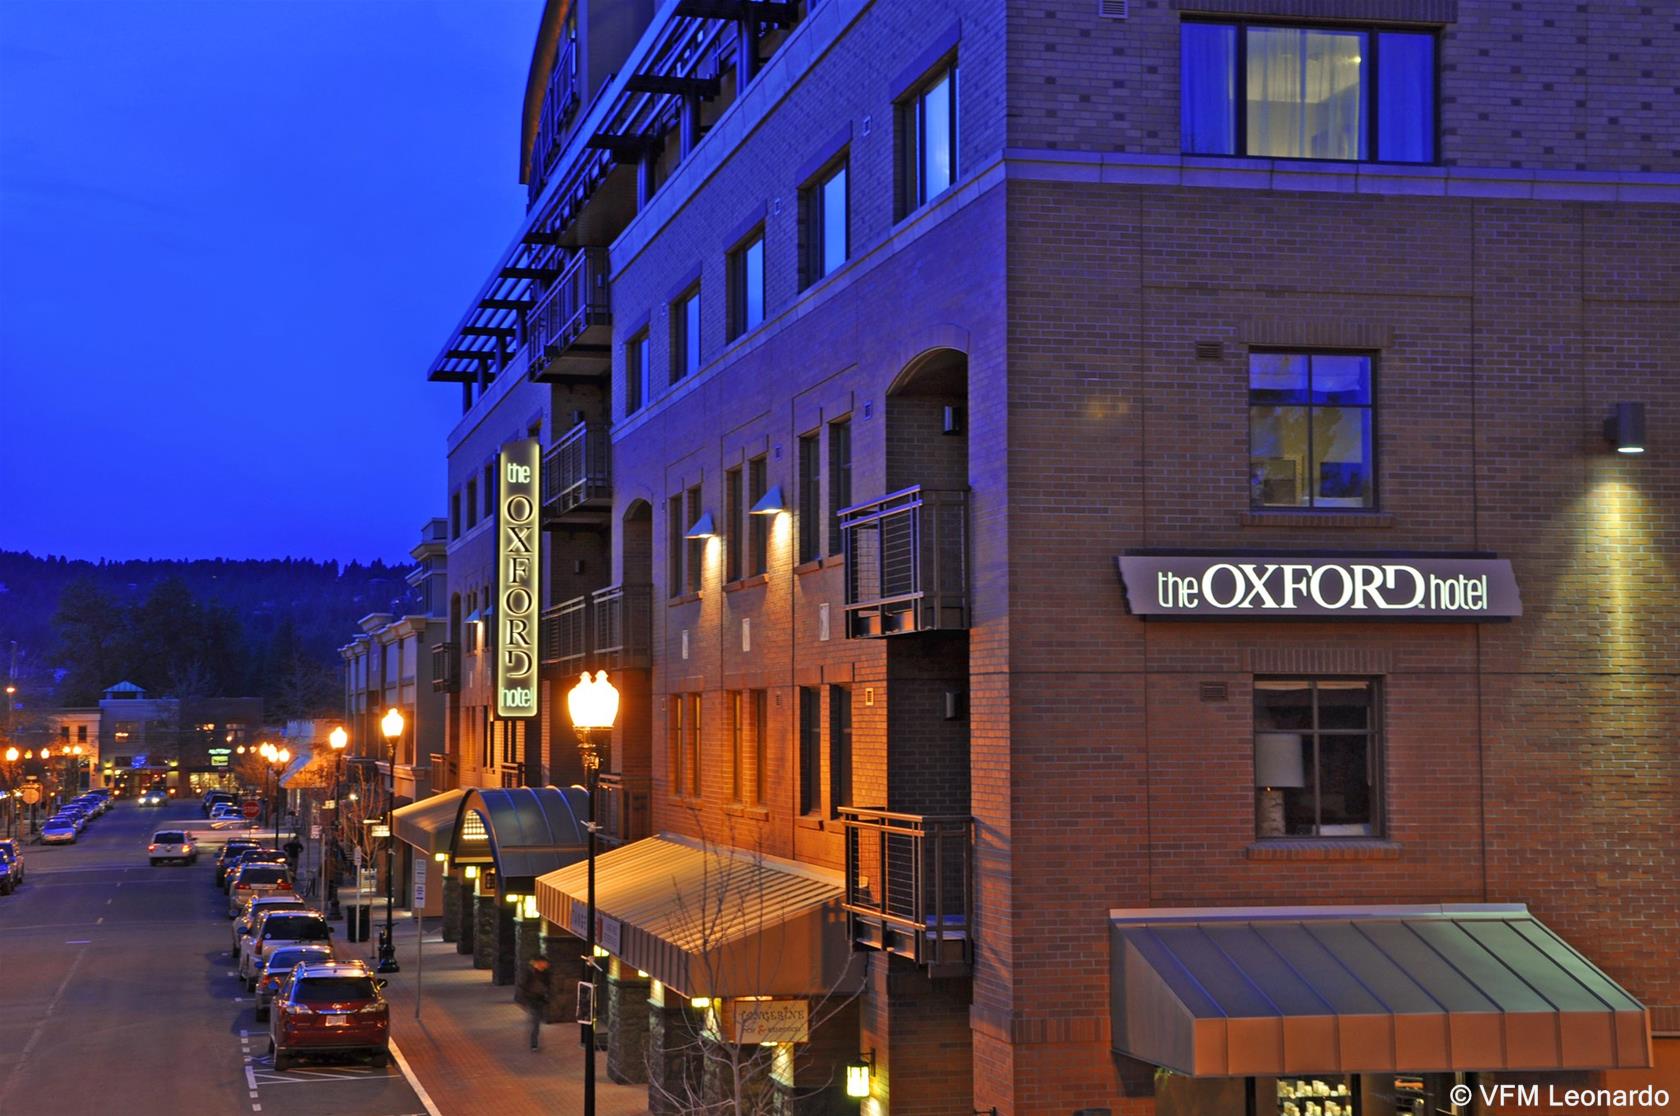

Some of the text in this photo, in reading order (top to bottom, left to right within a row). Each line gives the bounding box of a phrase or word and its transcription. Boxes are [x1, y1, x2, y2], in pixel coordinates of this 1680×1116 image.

[507, 462, 531, 484] the
[505, 496, 534, 678] OXFORD
[1157, 562, 1488, 610] the OXFORD hotel
